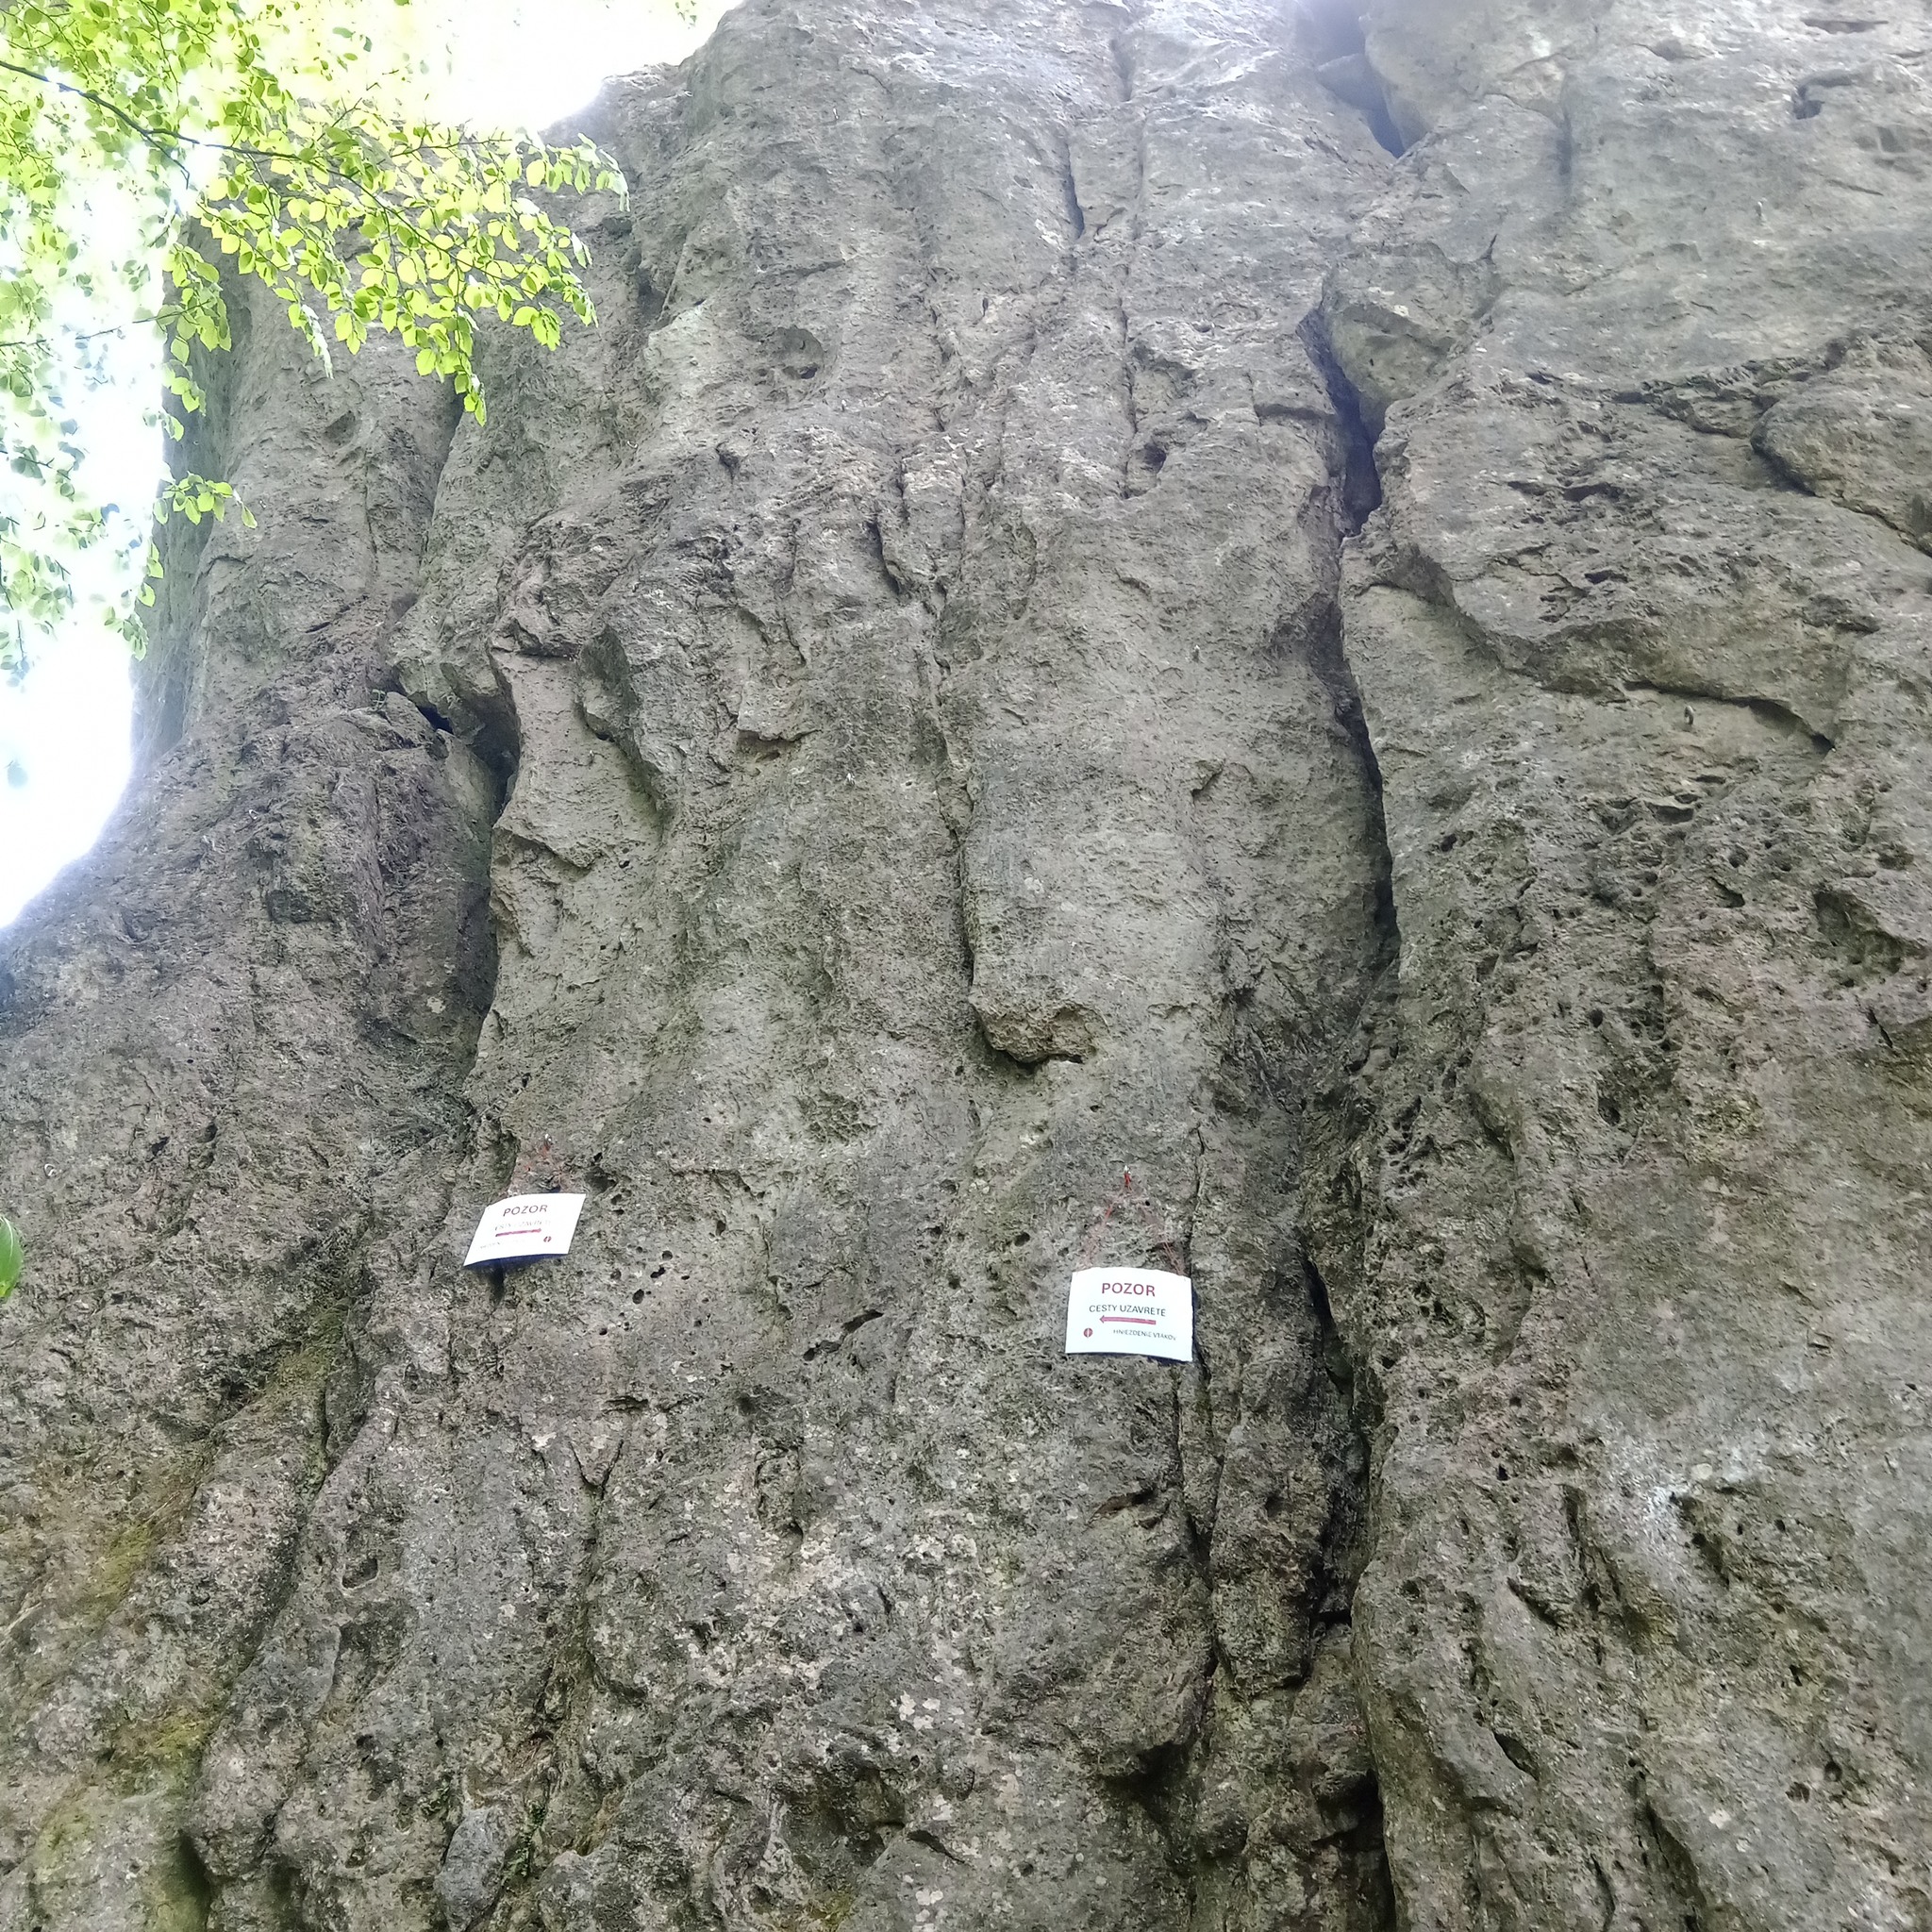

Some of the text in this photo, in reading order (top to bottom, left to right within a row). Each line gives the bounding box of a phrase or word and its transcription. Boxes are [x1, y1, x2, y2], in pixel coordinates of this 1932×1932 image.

[503, 1204, 548, 1217] POZOR
[1101, 1282, 1156, 1297] POZOR
[1089, 1304, 1118, 1313] CESTY
